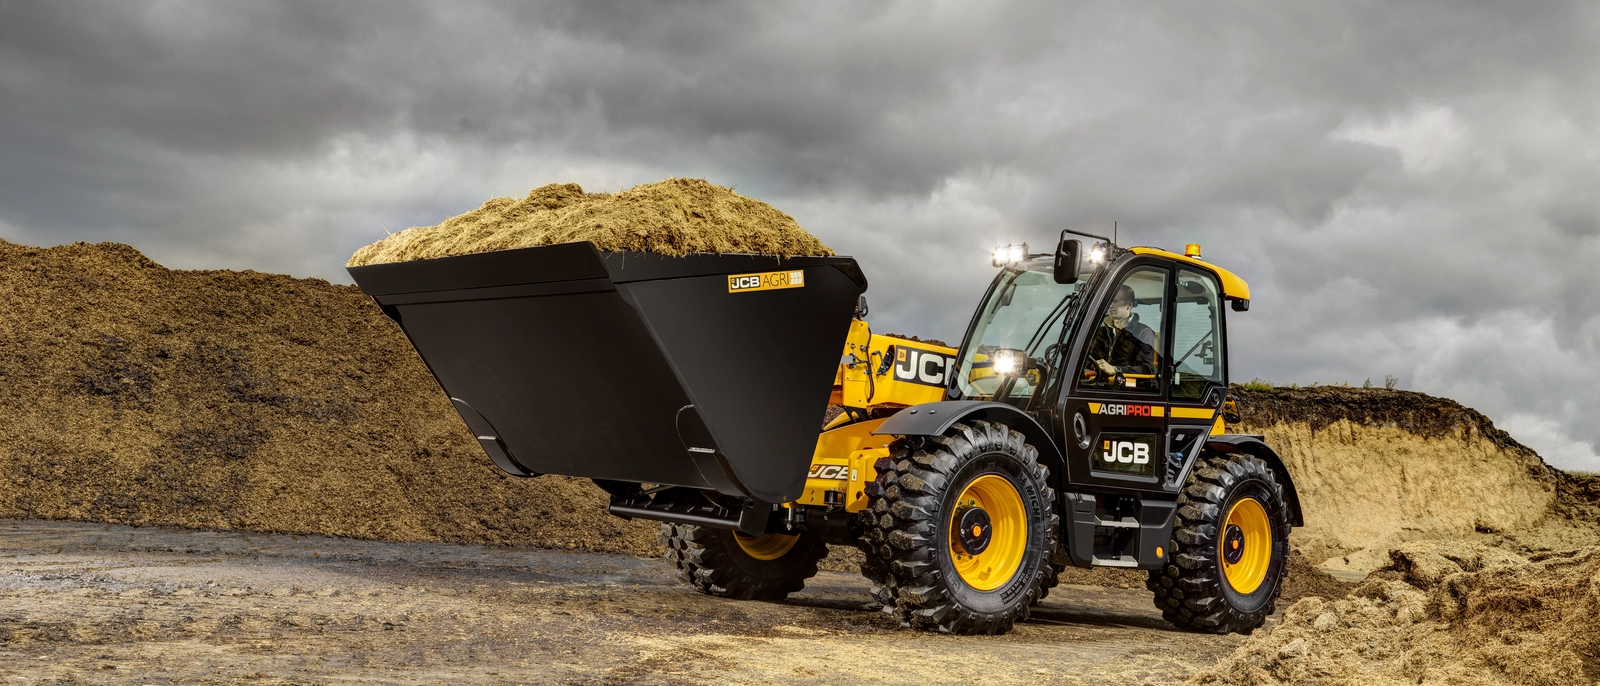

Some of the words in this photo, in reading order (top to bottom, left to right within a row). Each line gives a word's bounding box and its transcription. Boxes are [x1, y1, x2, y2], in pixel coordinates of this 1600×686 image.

[731, 276, 760, 289] JCB
[762, 273, 789, 287] AGRI
[1103, 440, 1150, 464] JCB
